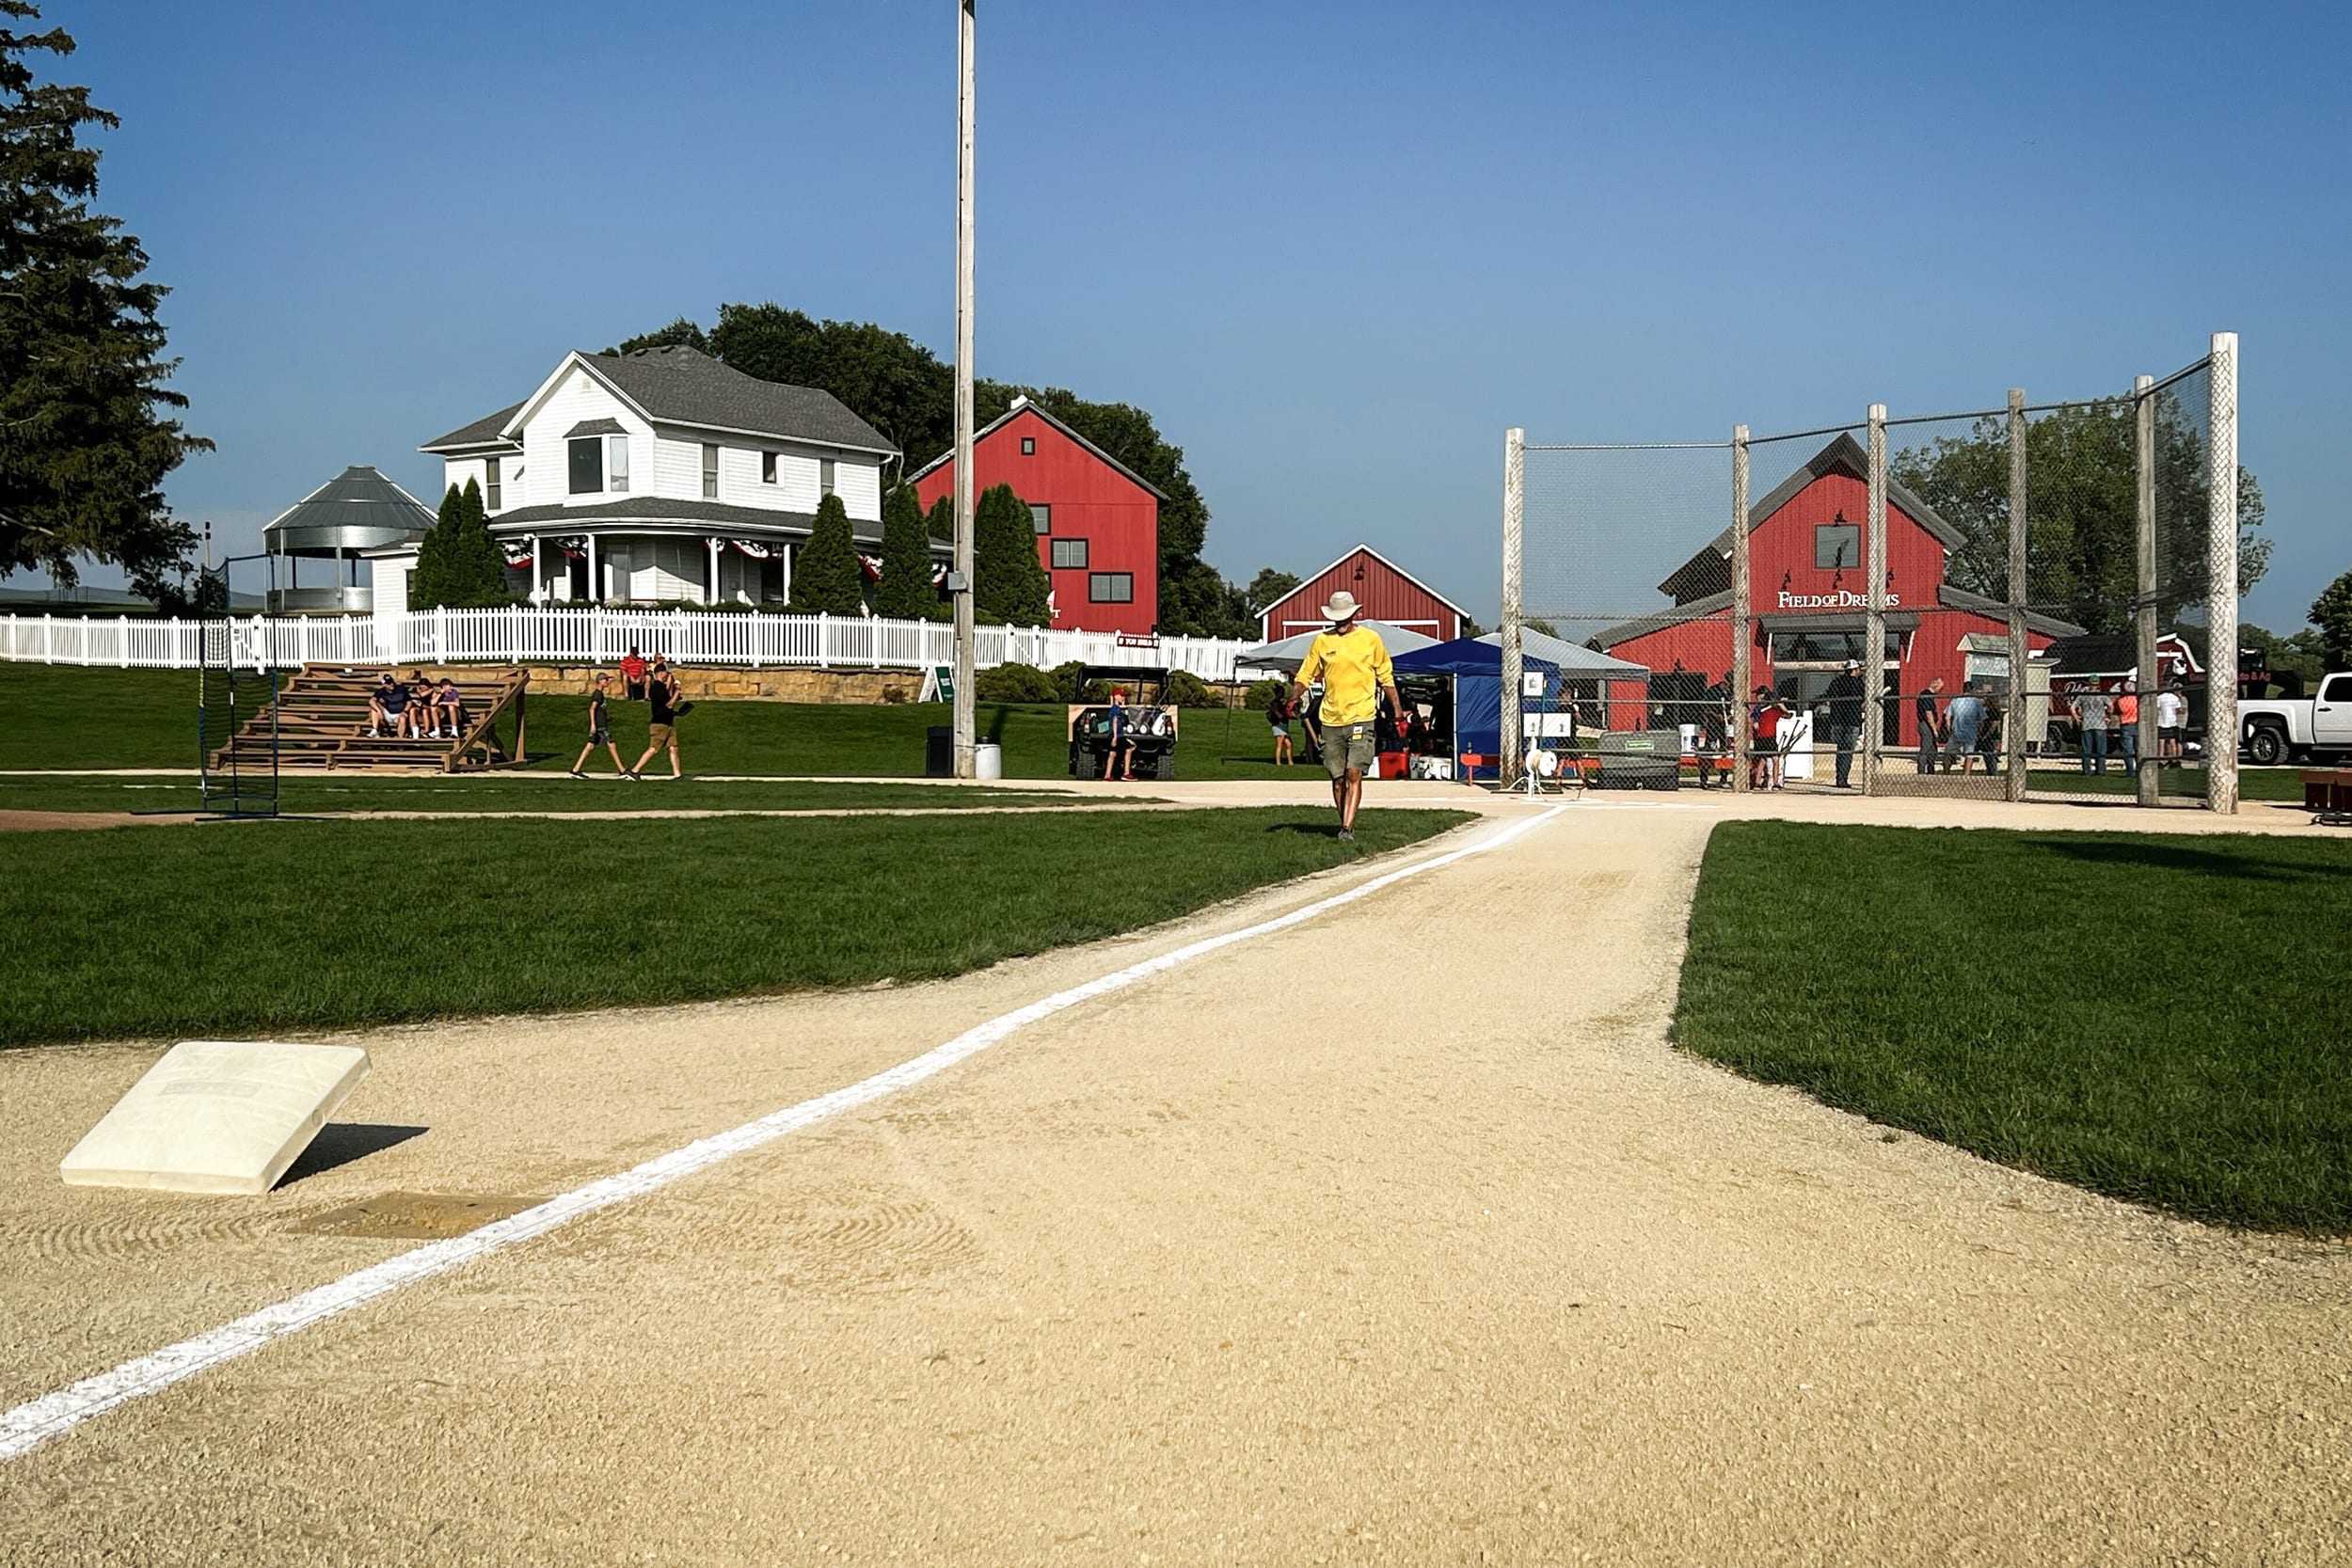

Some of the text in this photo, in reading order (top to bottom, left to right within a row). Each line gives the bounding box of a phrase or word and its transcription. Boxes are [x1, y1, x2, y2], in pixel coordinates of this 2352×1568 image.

[1777, 590, 1900, 608] FIELD OF DRES
[601, 616, 629, 627] FIELD
[641, 617, 683, 628] DREAMS
